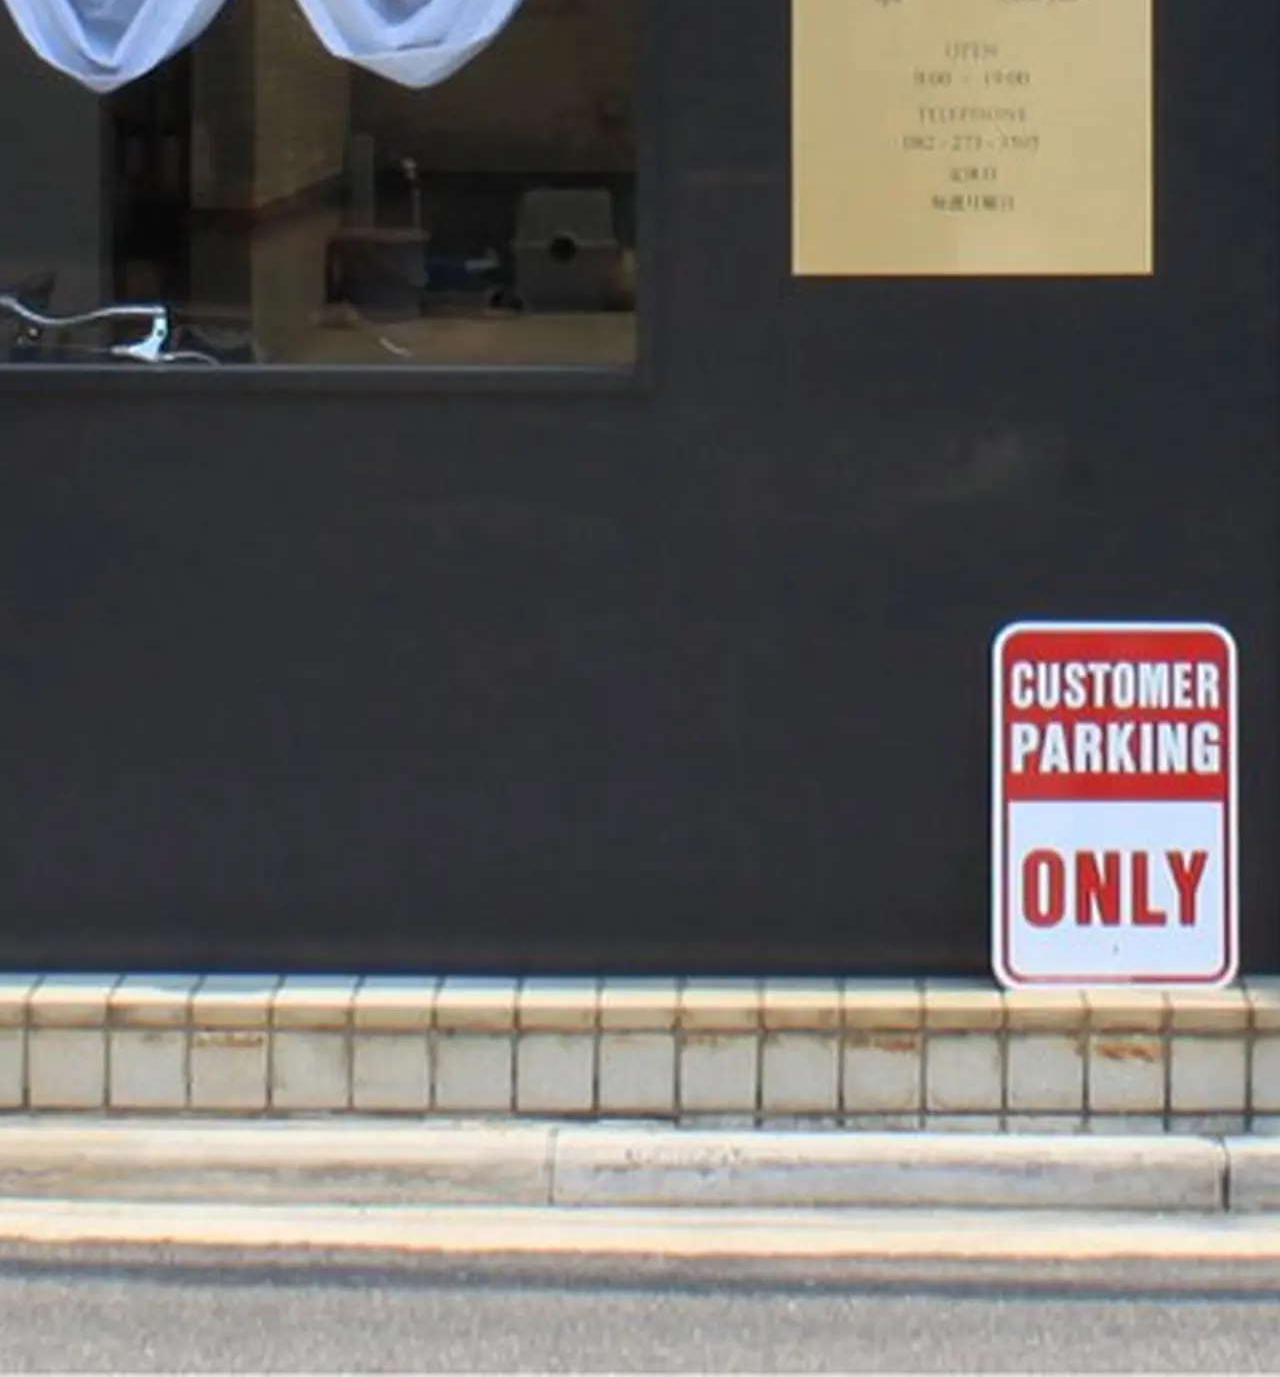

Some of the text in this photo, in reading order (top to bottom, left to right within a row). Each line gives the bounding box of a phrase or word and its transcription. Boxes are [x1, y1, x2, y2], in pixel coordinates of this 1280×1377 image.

[944, 41, 998, 60] OPEN
[919, 106, 1026, 124] TELEPHONE
[1010, 660, 1220, 710] CUSTOMER
[1010, 722, 1221, 774] PARKING
[1021, 848, 1209, 928] ONLY
